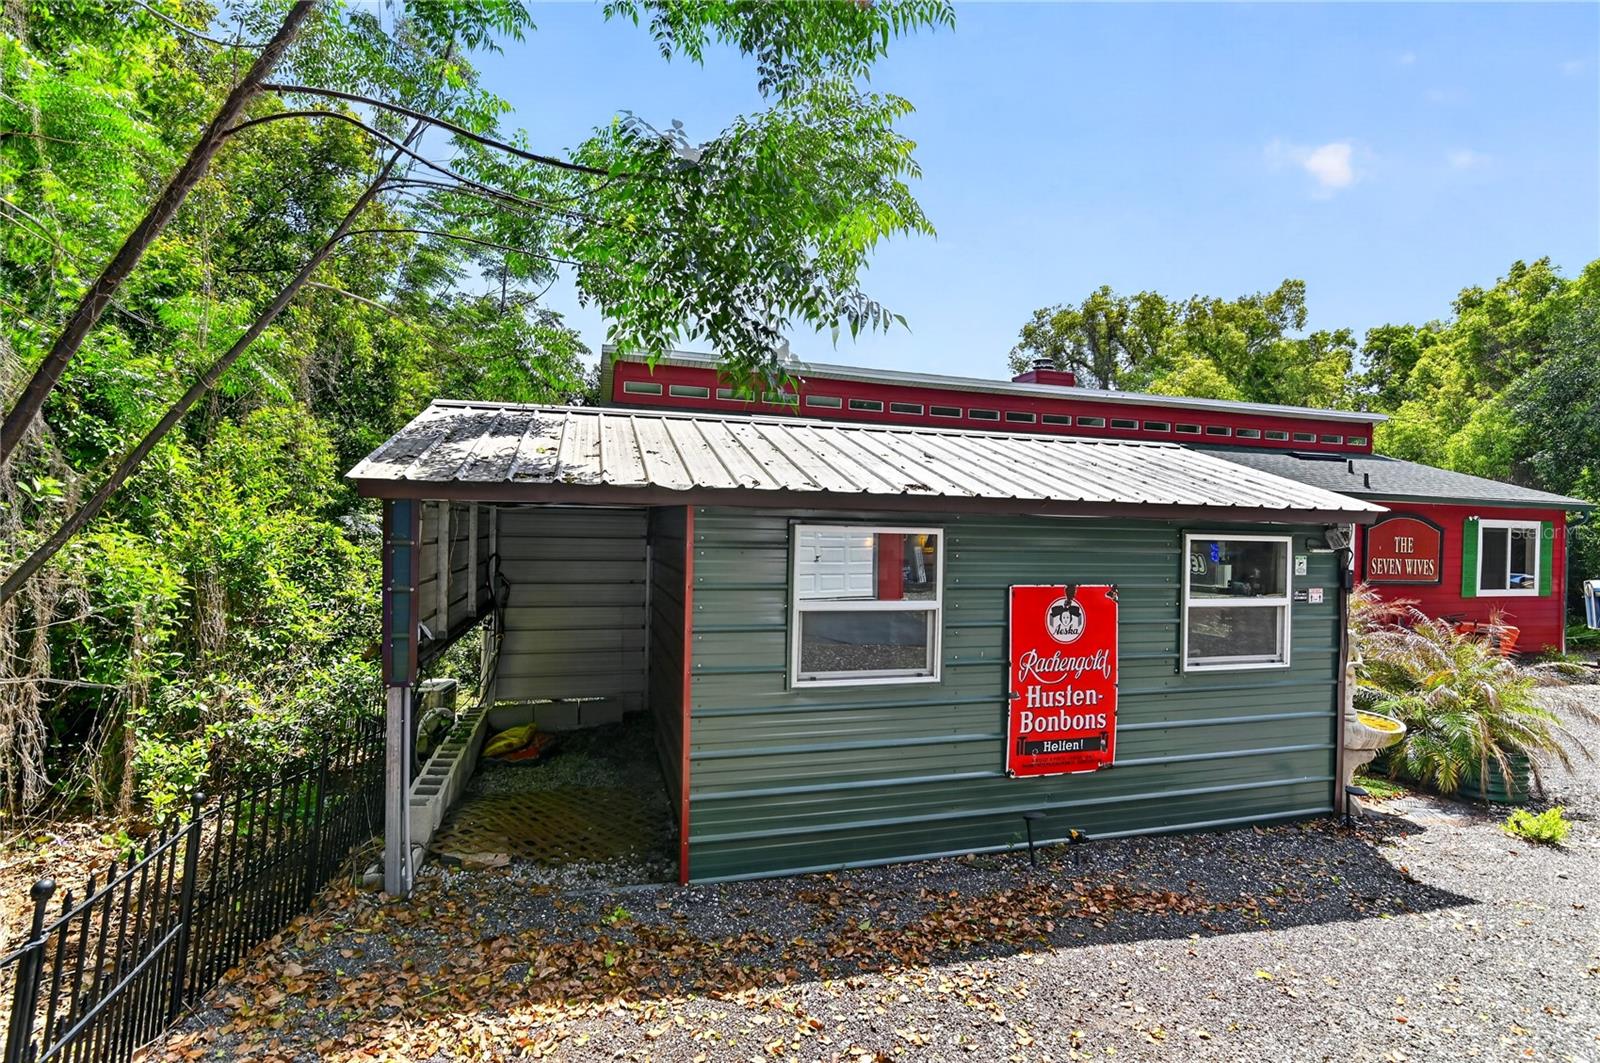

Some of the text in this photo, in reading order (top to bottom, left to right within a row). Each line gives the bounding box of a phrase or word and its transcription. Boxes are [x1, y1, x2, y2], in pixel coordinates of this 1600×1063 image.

[1394, 536, 1414, 553] THE
[1371, 557, 1435, 575] SEVEN WIVES
[1019, 648, 1111, 684] Rachengold
[1026, 684, 1104, 708] Husten-
[1020, 709, 1107, 734] Bonbons
[1043, 739, 1084, 753] Helfen!
